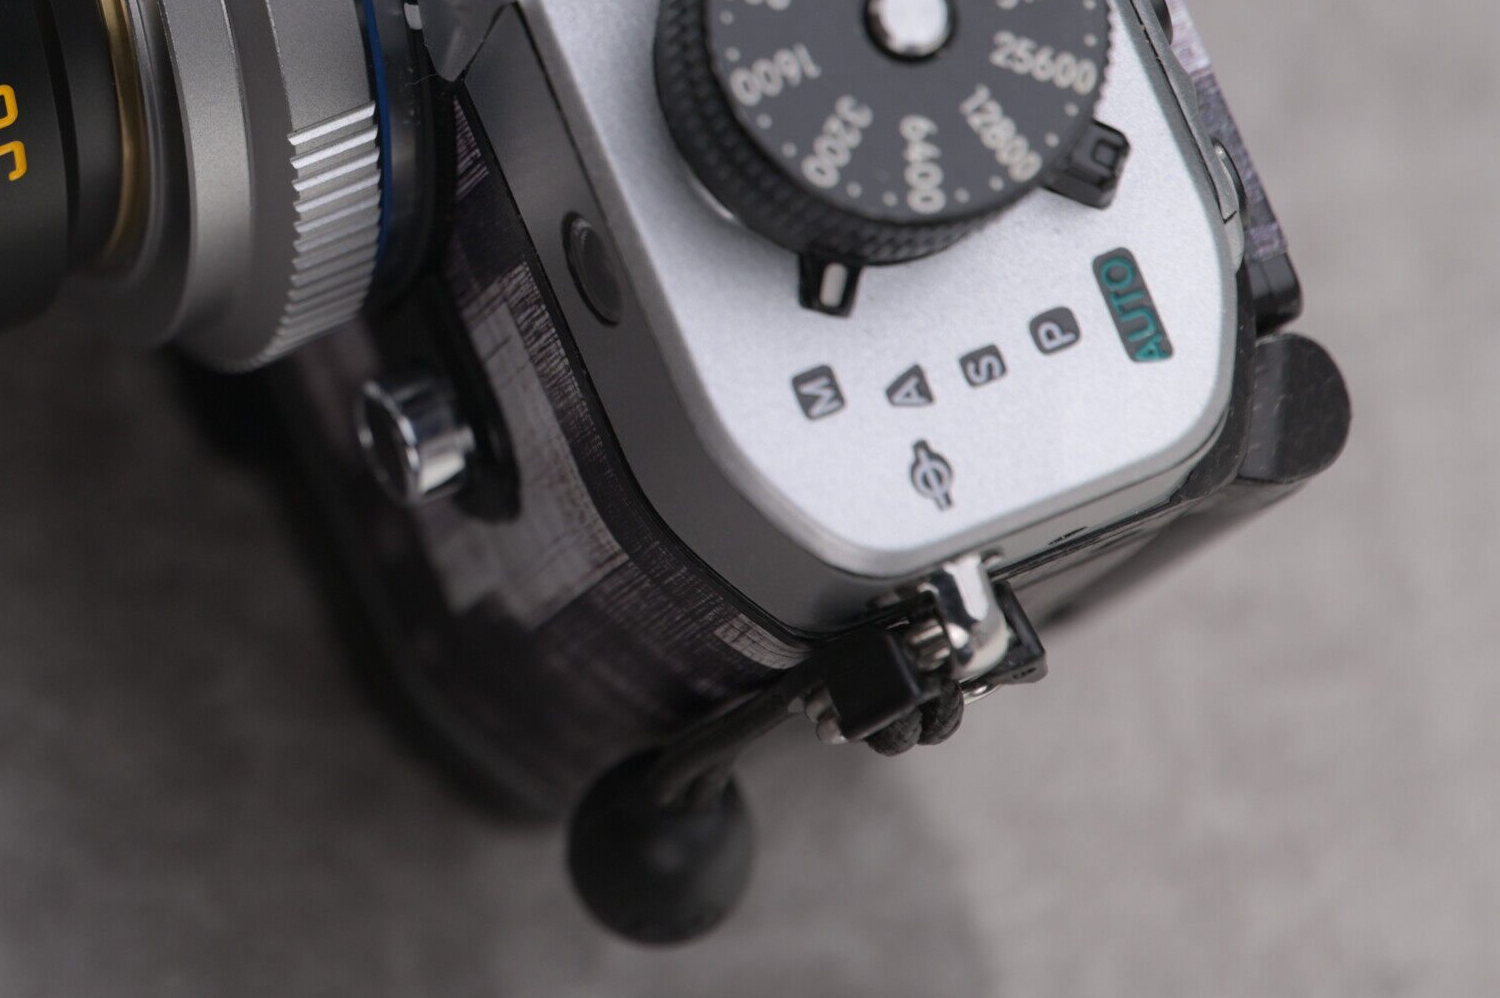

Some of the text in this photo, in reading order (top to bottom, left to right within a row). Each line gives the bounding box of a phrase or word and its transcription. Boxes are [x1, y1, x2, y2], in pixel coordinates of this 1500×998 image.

[729, 42, 822, 106] 1600
[989, 30, 1098, 95] 25600
[800, 95, 874, 190] 3200
[899, 114, 947, 214] 6400
[959, 83, 1043, 183] 12800
[1037, 321, 1077, 351] P
[1100, 257, 1169, 362] AUTO
[798, 374, 844, 419] M
[891, 372, 925, 404] A
[966, 352, 1003, 381] S
